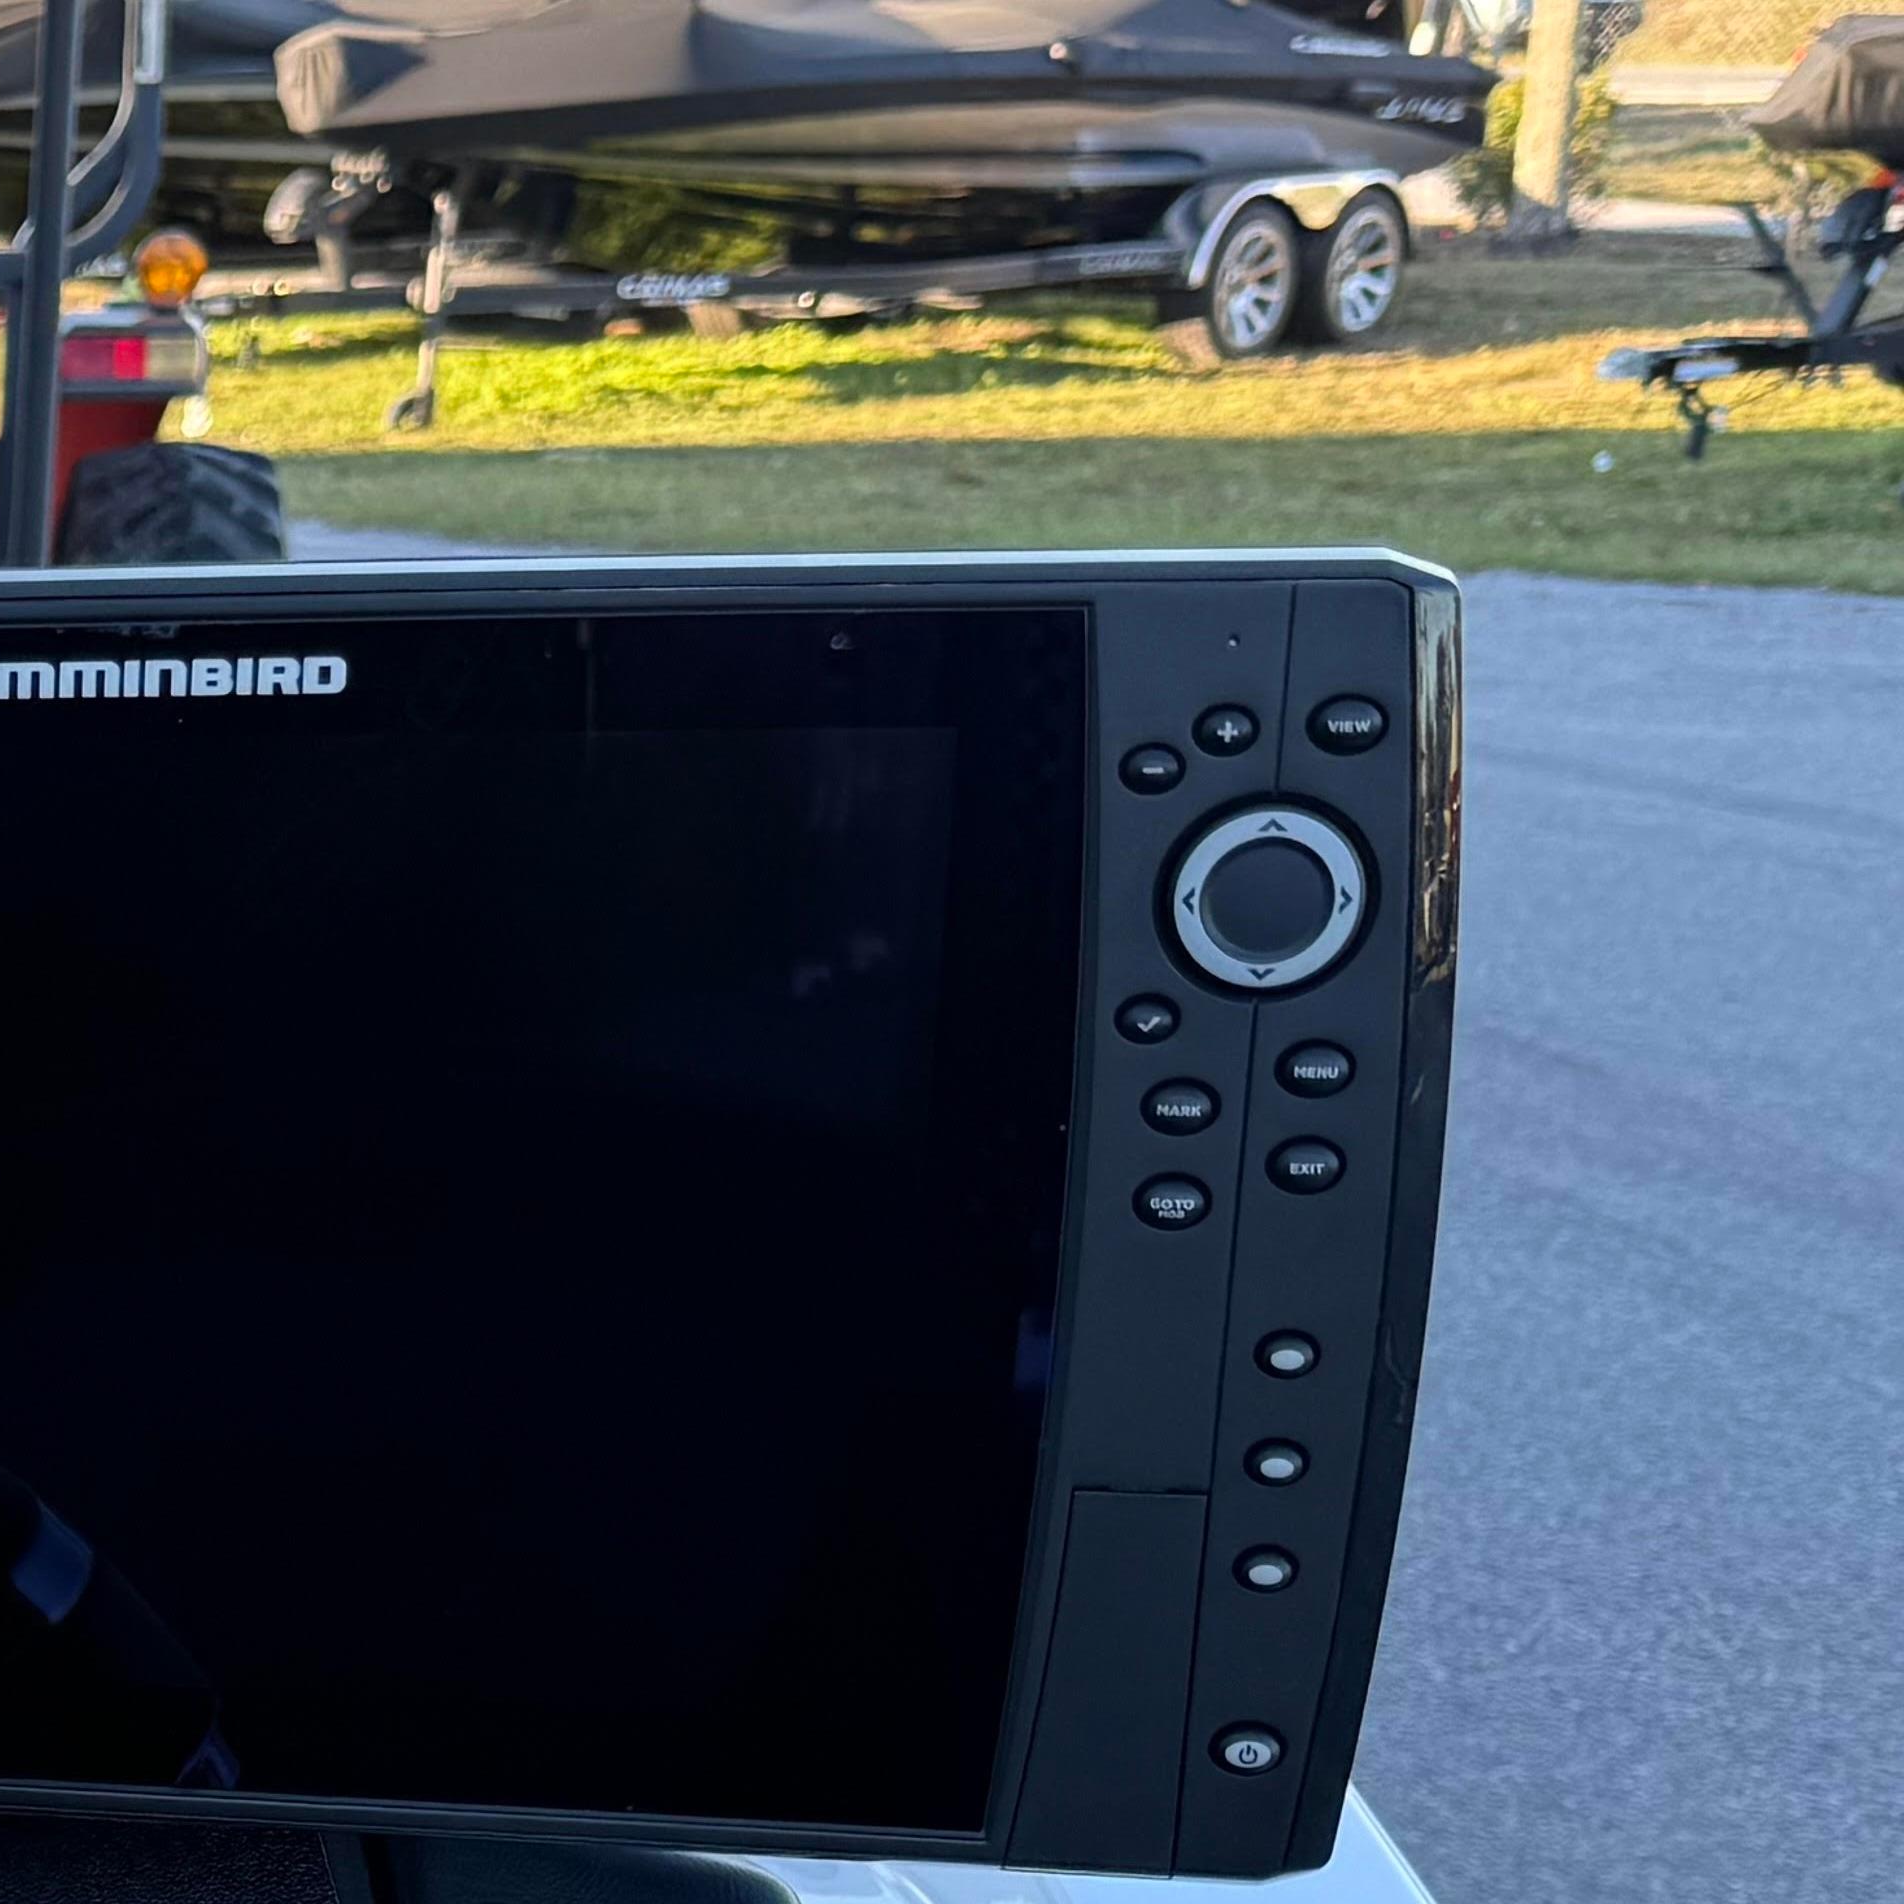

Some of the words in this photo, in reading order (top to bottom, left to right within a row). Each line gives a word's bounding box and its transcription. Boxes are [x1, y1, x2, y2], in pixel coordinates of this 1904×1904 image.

[1328, 718, 1372, 734] VIEW
[1293, 1065, 1340, 1079] MENU
[1156, 1103, 1202, 1118] MARK
[1288, 1162, 1326, 1175] EXIT
